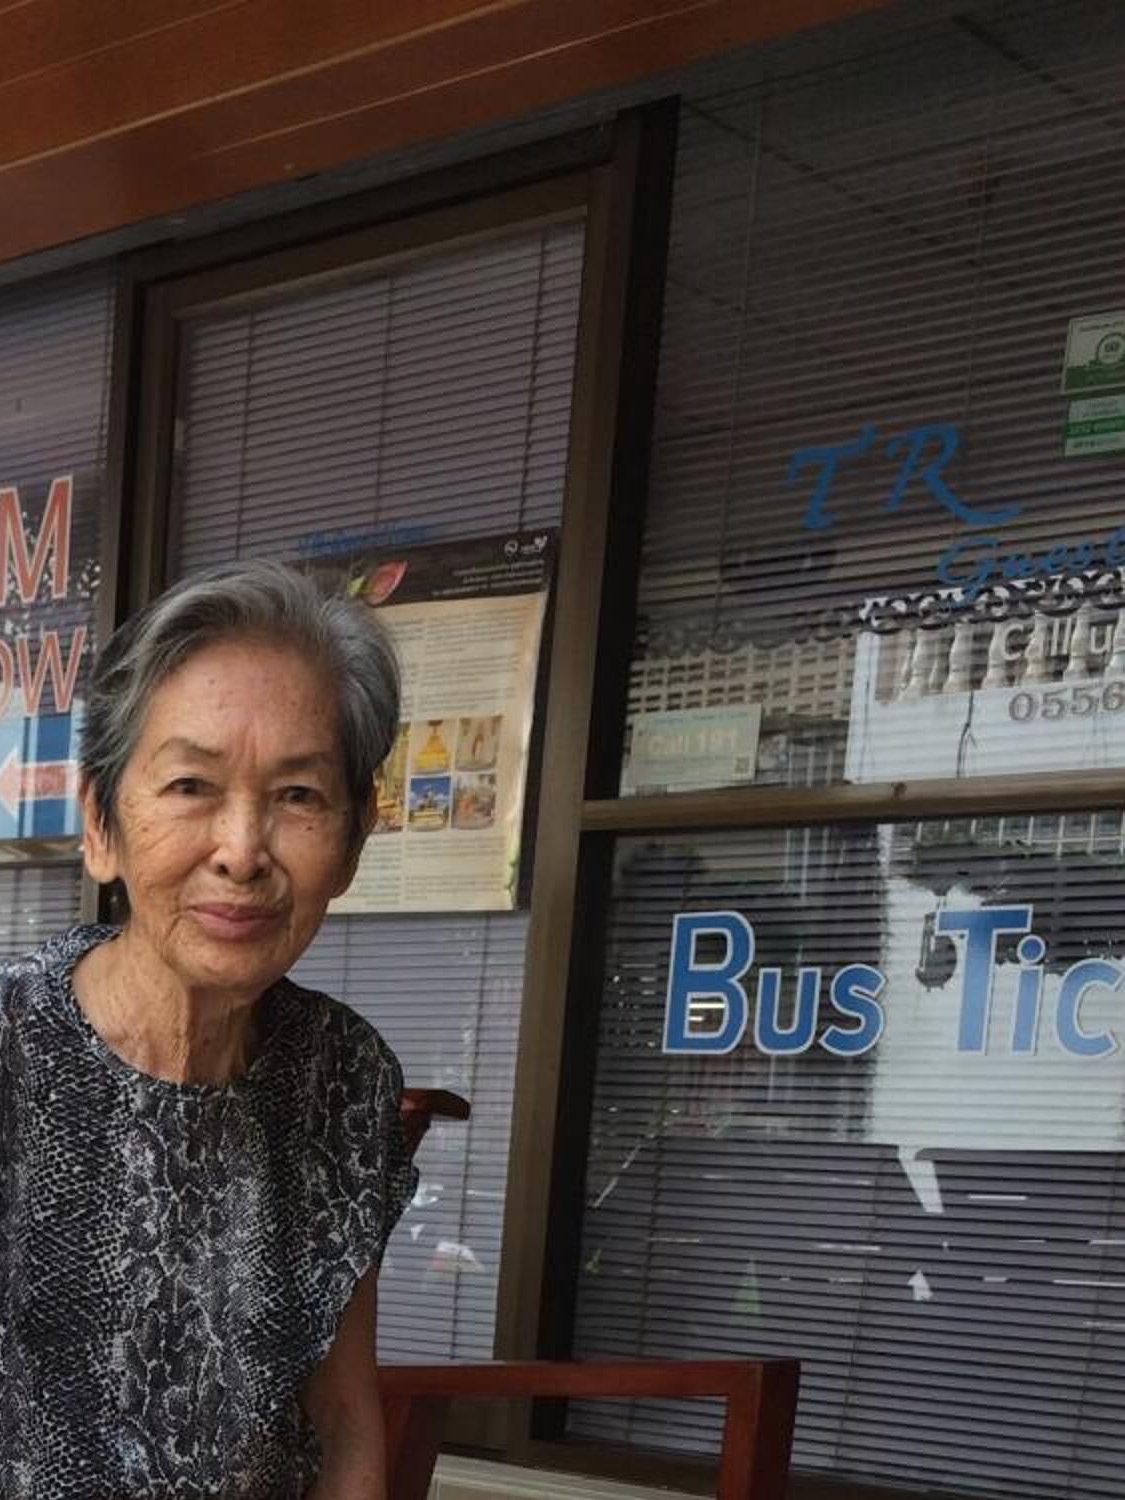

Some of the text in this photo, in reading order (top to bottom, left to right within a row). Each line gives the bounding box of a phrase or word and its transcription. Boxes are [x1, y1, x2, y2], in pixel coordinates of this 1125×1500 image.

[1008, 680, 1125, 722] 0556
[662, 904, 1125, 1057] Bus Tic
